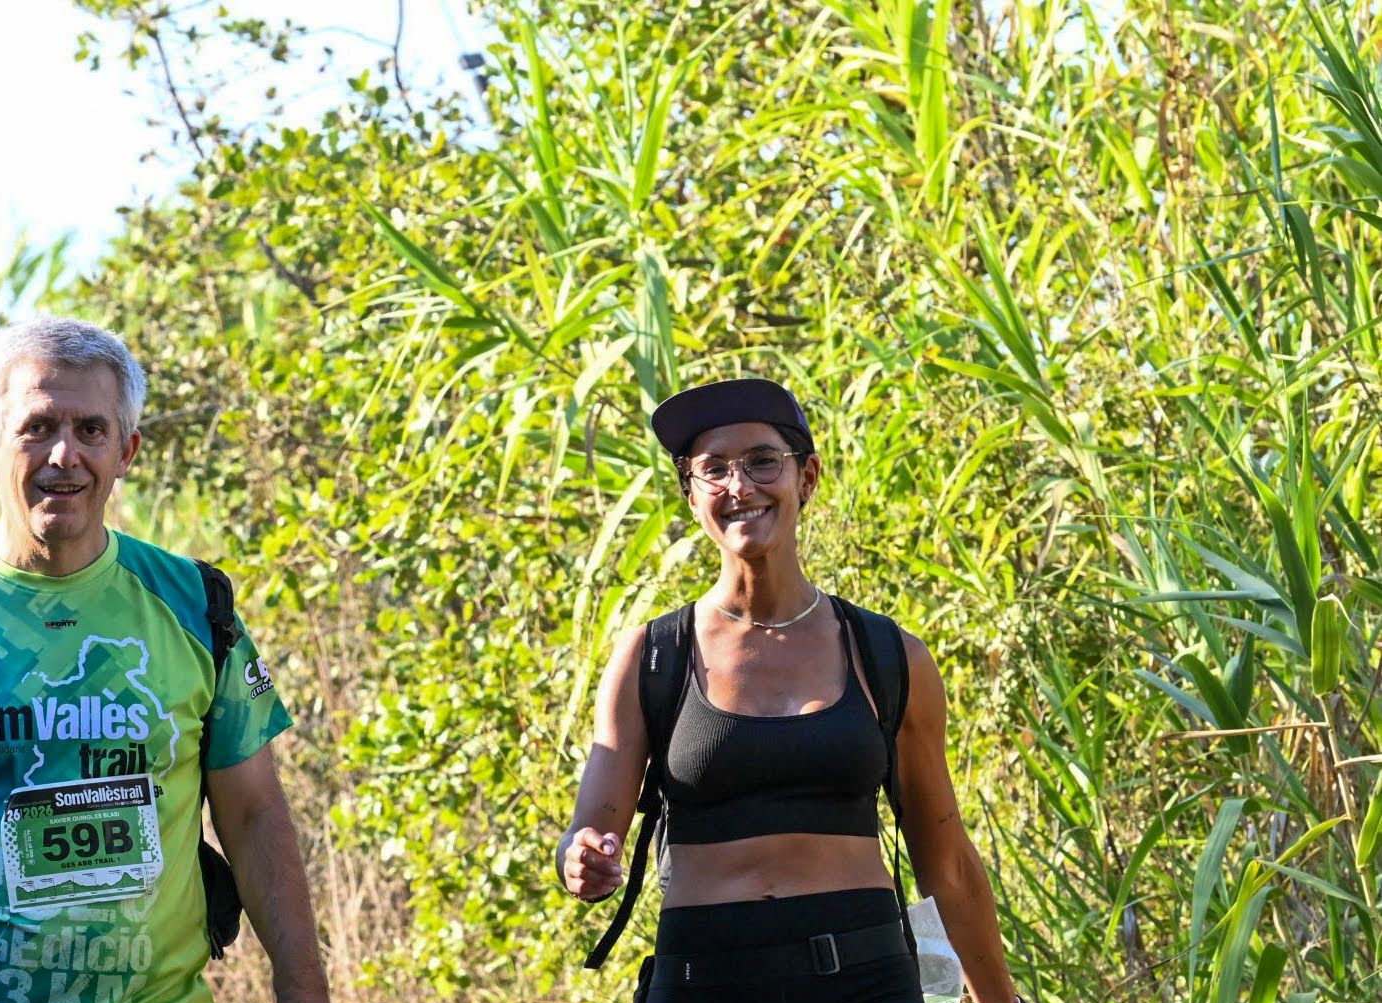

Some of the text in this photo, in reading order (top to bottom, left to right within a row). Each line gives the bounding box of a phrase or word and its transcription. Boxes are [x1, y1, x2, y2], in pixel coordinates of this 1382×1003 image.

[78, 743, 147, 780] trail
[54, 785, 144, 808] SomVallèstrail
[49, 815, 72, 824] XAVIER
[42, 819, 134, 862] 59B
[94, 857, 116, 866] TRAIL
